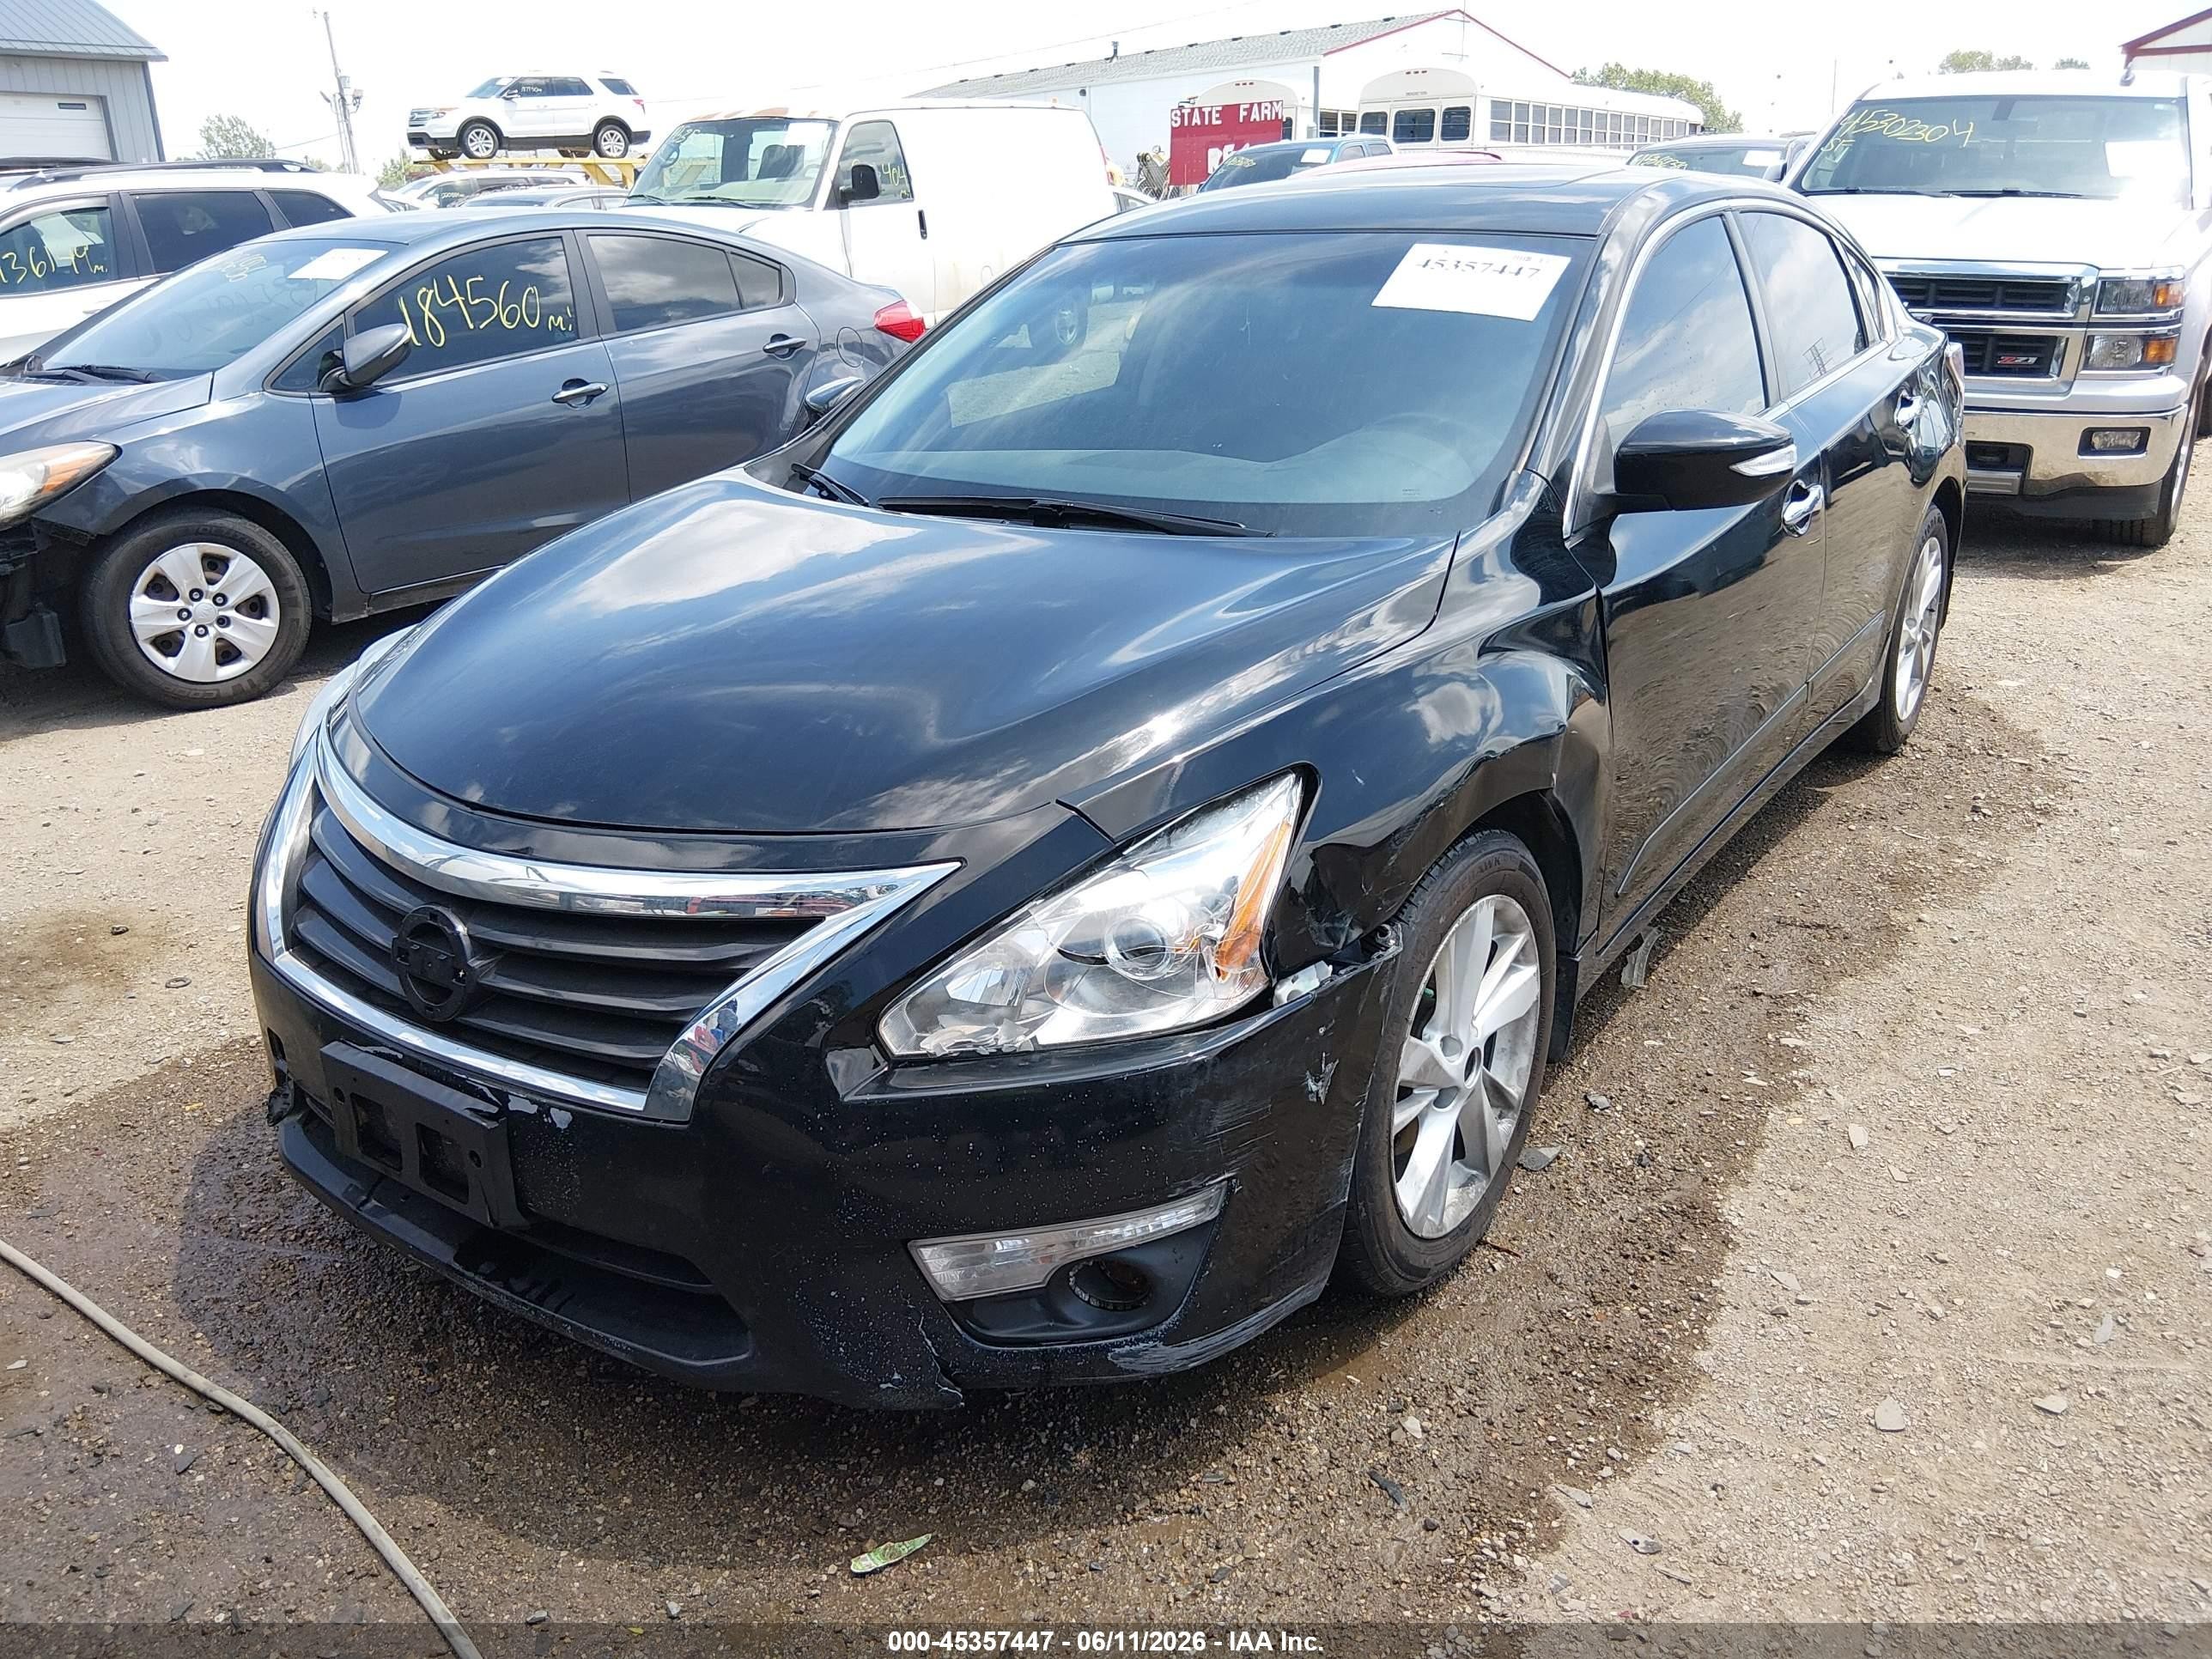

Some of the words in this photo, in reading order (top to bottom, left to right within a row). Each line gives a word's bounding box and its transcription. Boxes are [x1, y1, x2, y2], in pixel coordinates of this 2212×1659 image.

[1171, 106, 1223, 128] STATE
[1239, 100, 1283, 123] FARM
[1839, 109, 1974, 149] 45302304
[398, 275, 540, 348] 184560
